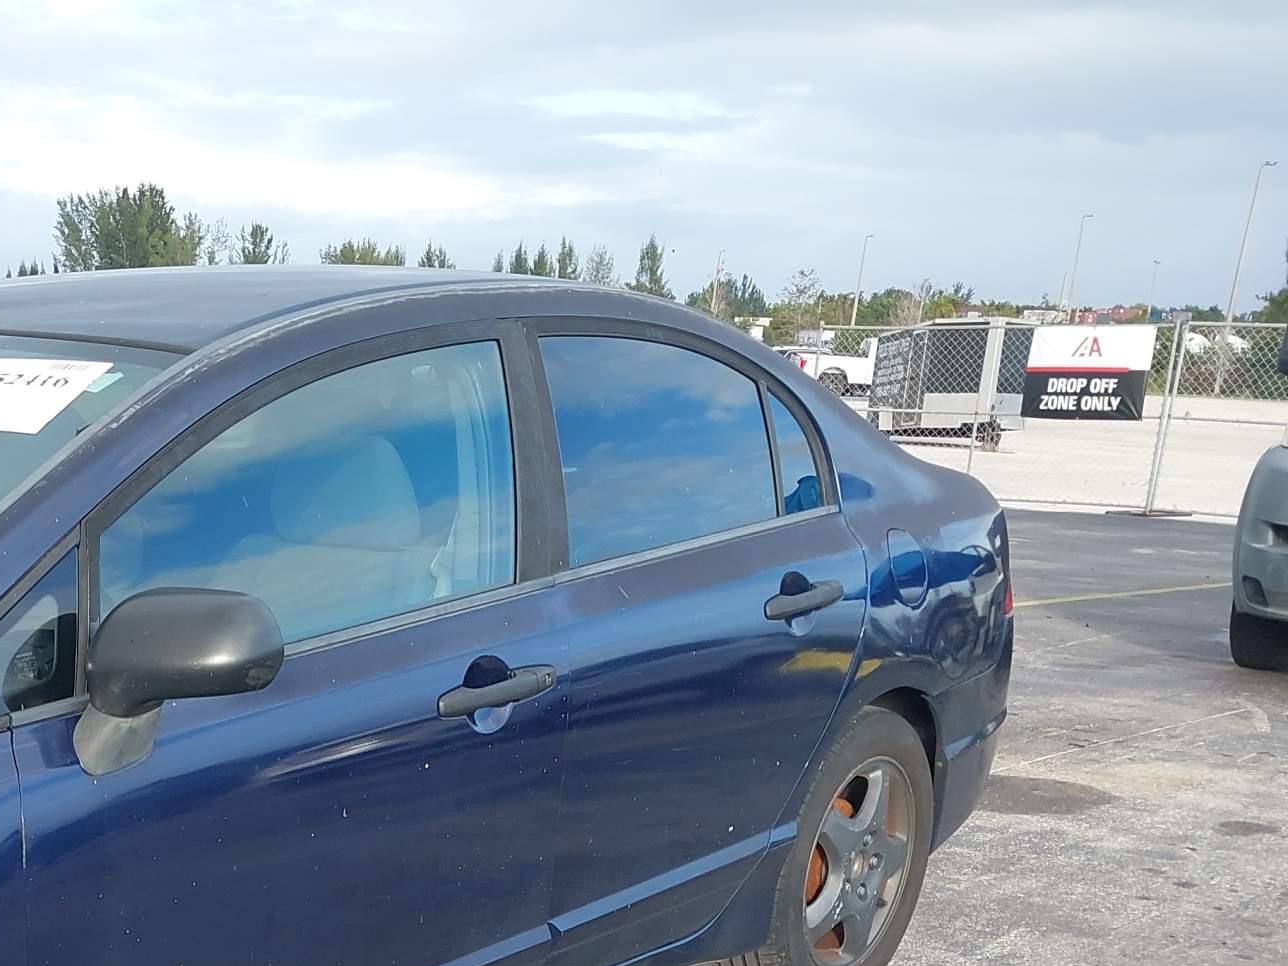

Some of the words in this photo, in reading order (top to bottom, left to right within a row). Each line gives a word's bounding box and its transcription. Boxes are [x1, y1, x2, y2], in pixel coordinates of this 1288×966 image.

[1047, 378, 1087, 393] DROP
[1089, 378, 1119, 394] OFF
[1039, 395, 1078, 411] ZONE
[1080, 395, 1122, 411] ONLY
